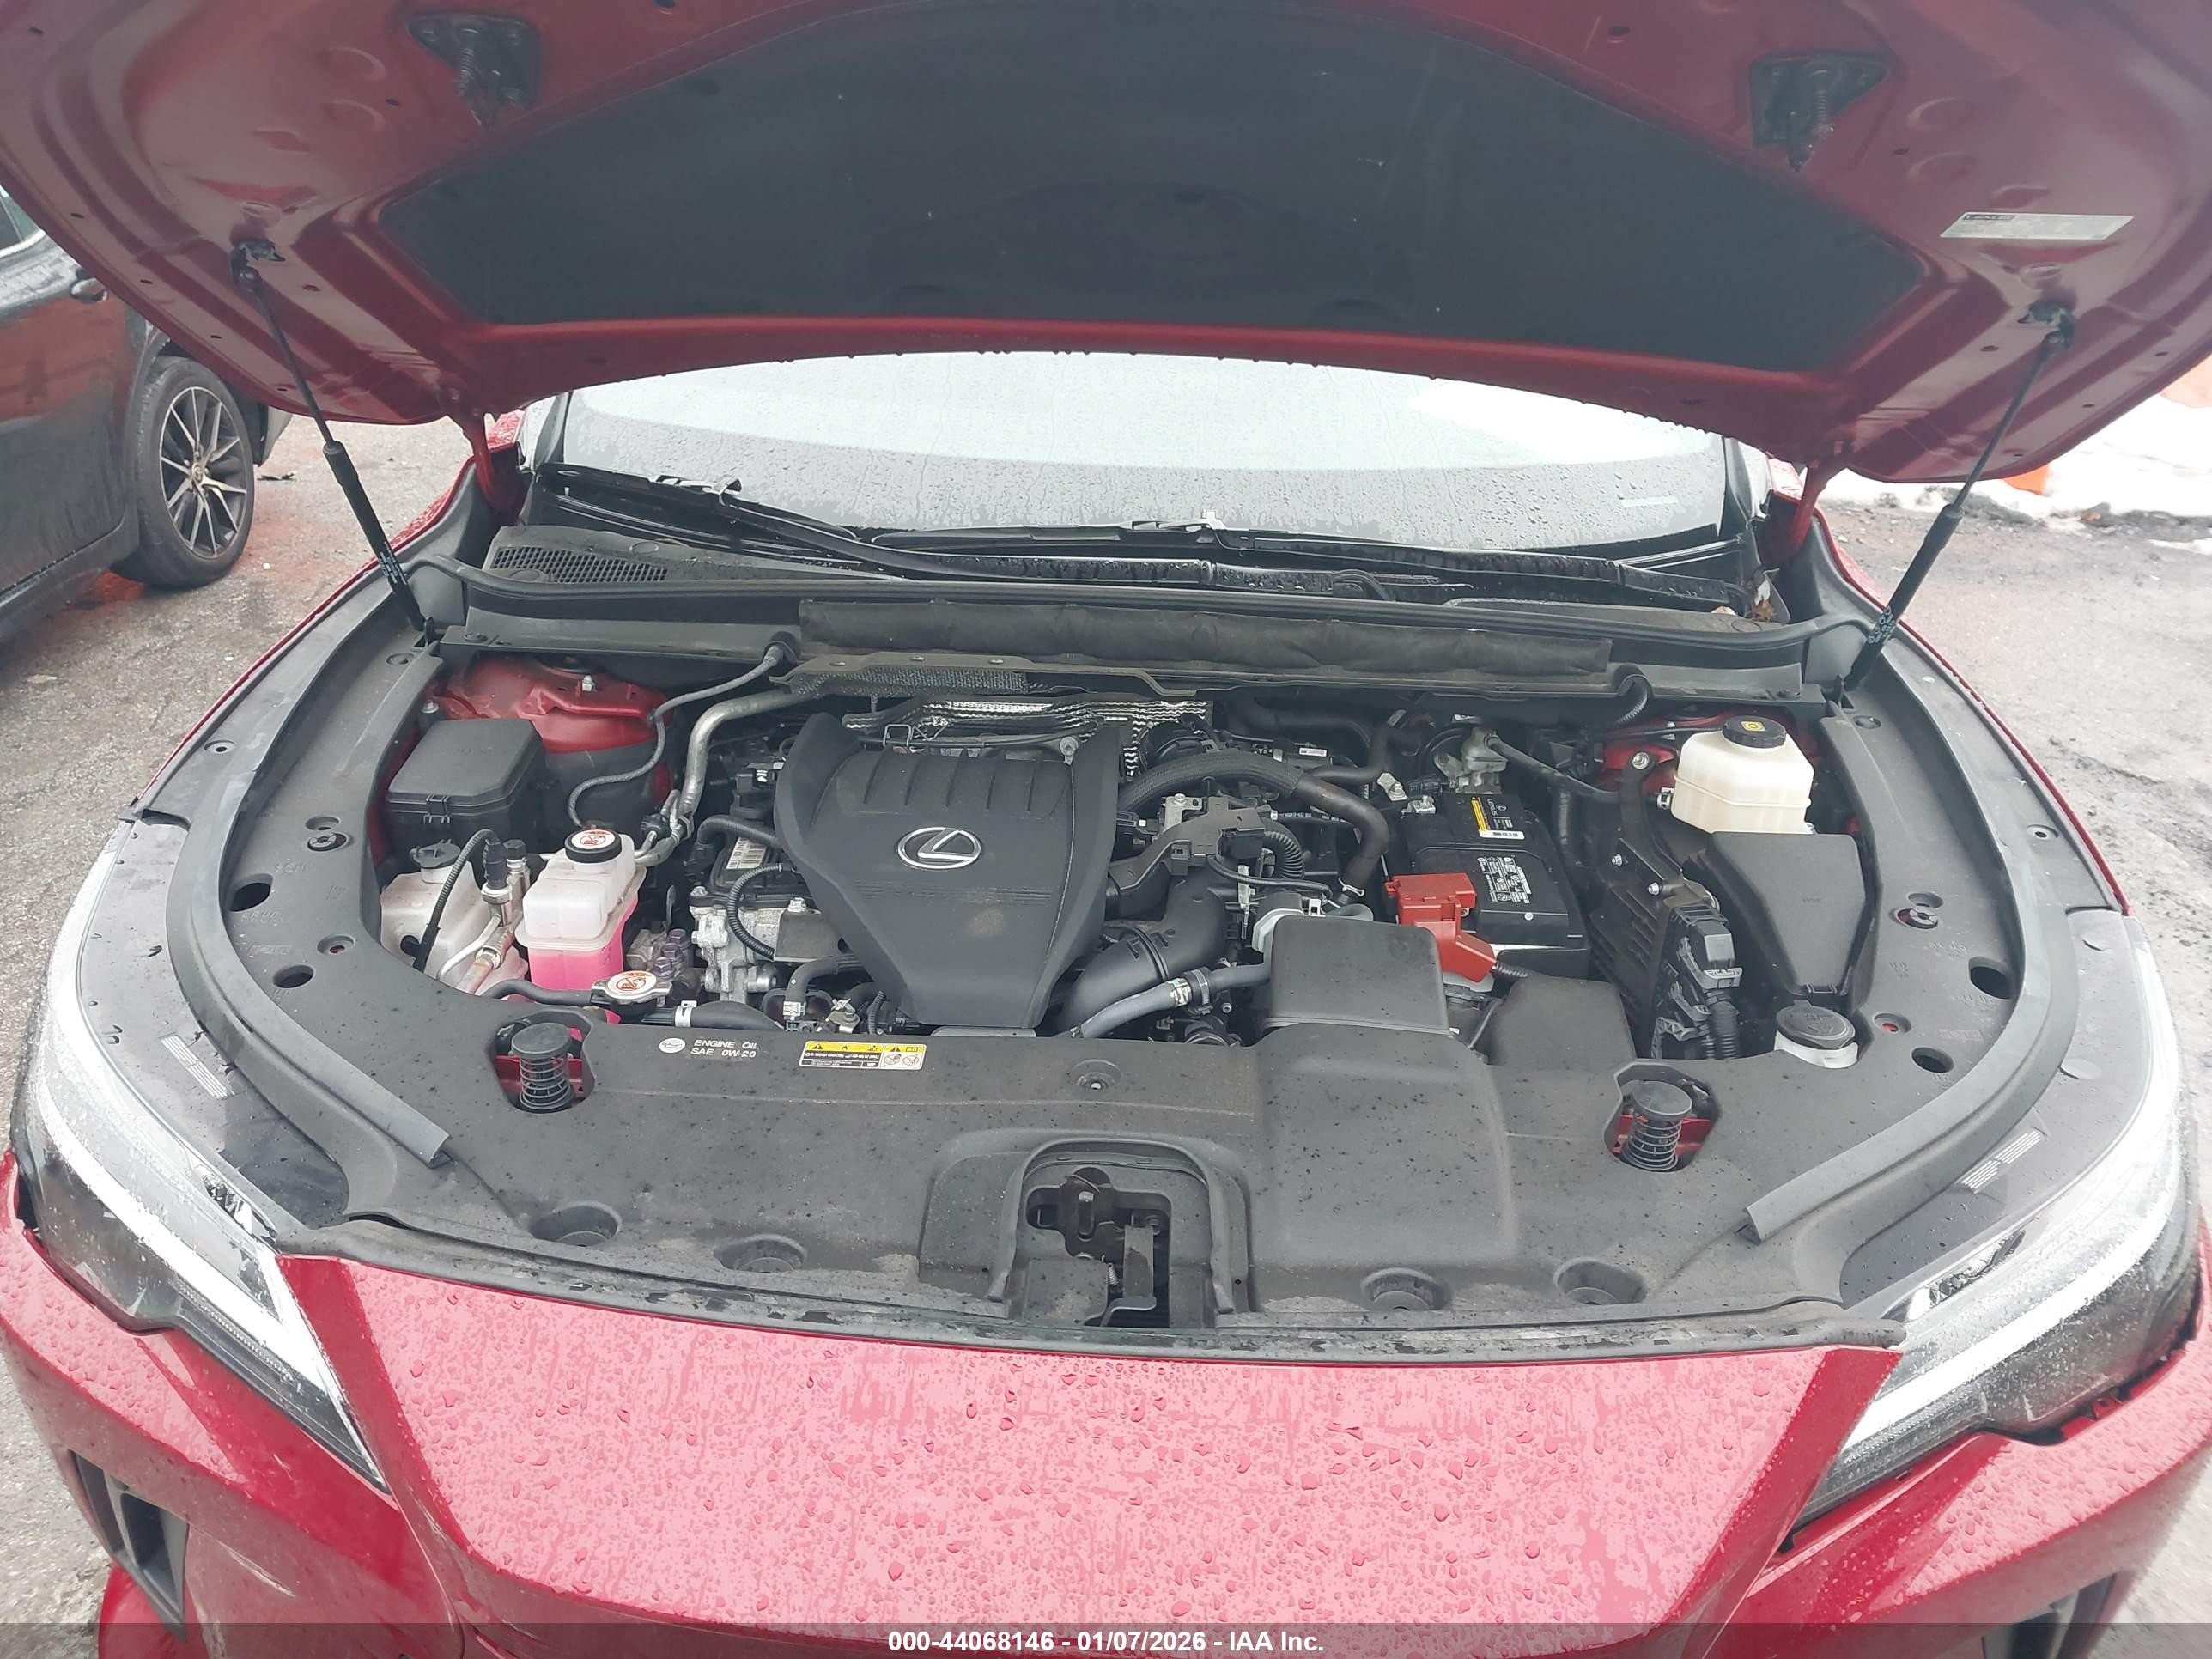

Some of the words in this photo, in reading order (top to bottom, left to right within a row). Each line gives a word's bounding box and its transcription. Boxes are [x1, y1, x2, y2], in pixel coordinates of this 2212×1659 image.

[693, 1039, 736, 1048] ENGINE
[690, 1048, 714, 1056] SAE
[721, 1049, 757, 1058] 0W-20
